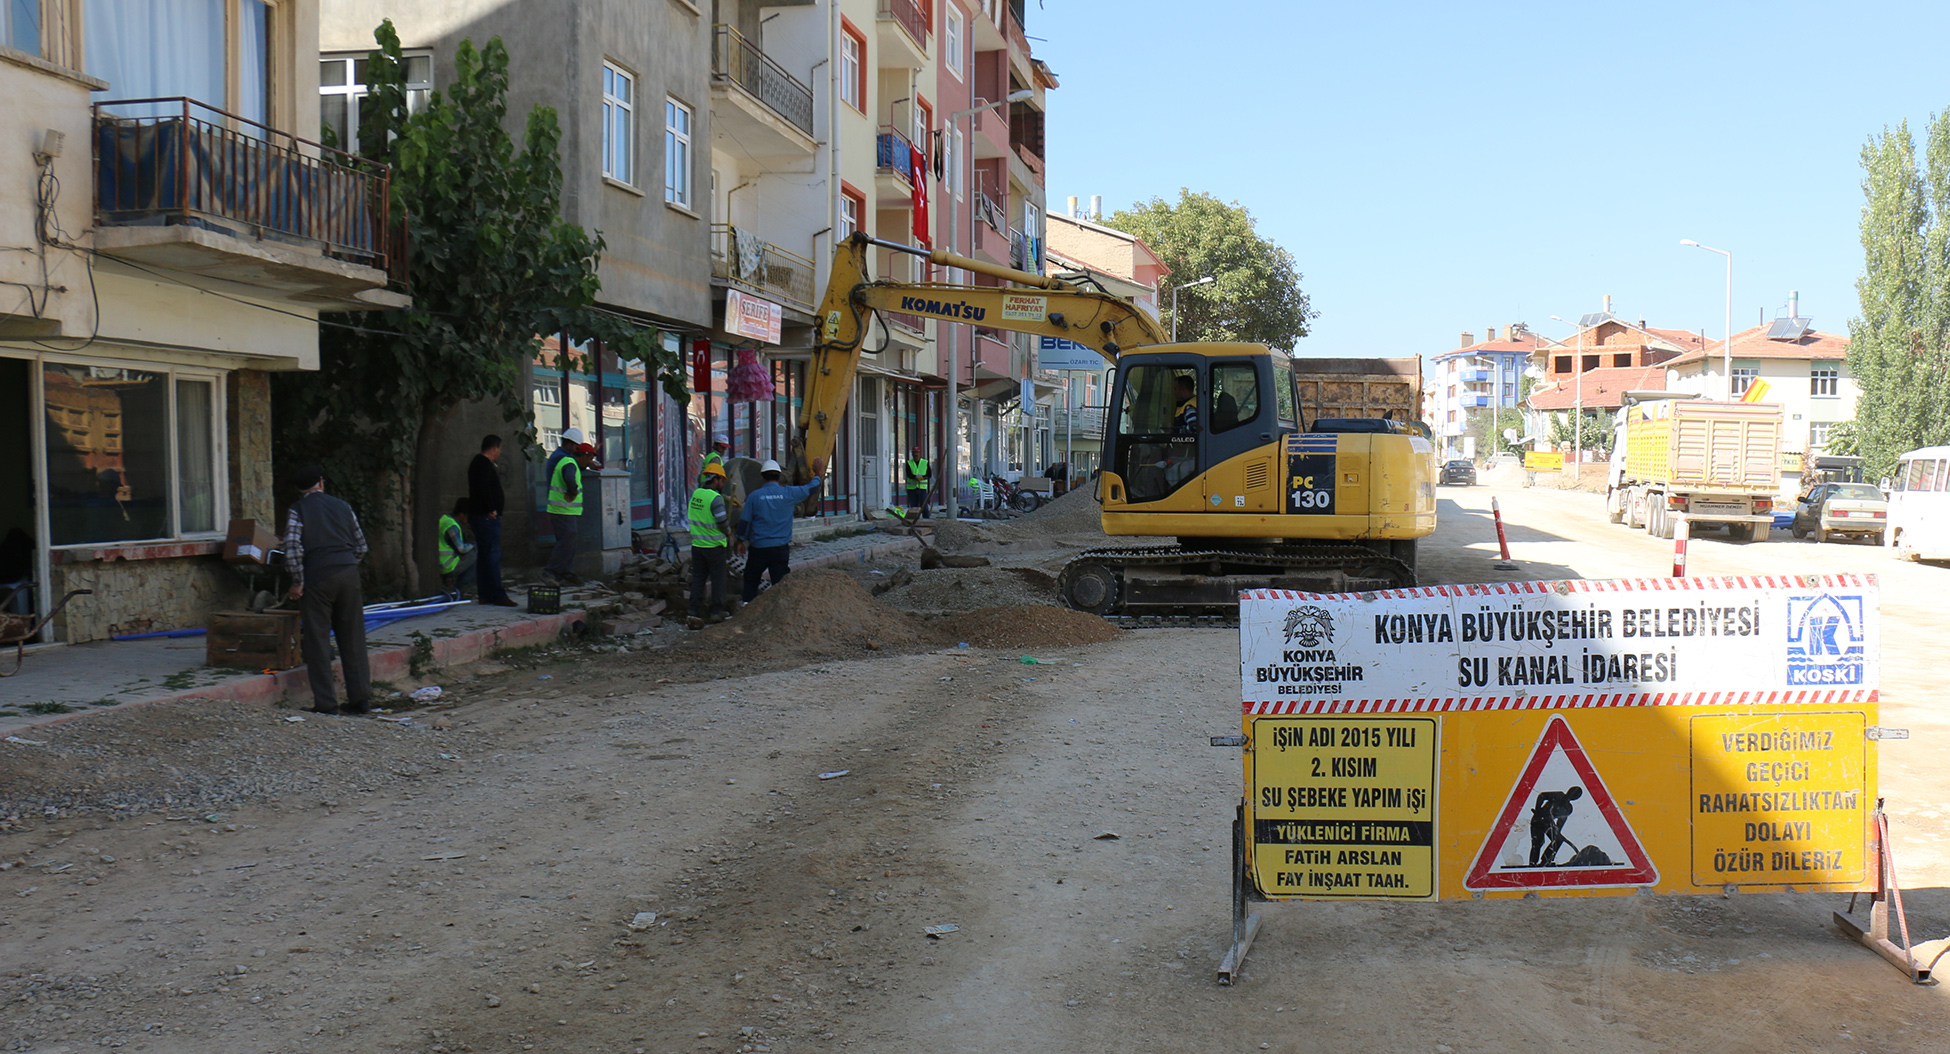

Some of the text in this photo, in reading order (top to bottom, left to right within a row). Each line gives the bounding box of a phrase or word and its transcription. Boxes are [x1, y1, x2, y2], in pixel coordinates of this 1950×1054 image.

[901, 296, 986, 321] KOMATSU
[1041, 335, 1092, 350] BEK
[1292, 476, 1313, 489] PC
[1291, 491, 1330, 508] 130
[1375, 600, 1760, 648] KONYA BÜYÜKŞEHİR BELEDİYESİ
[1283, 650, 1336, 662] KONYA
[1257, 663, 1364, 683] BÜYÜKŞEHİR
[1460, 646, 1676, 687] SU KANAL İDARESİ
[1793, 666, 1856, 683] KOSKİ
[1278, 683, 1342, 695] BELEDİYESİ
[1309, 728, 1335, 747] ADI
[1341, 727, 1381, 747] 2015
[1387, 728, 1416, 747] YILI
[1311, 757, 1377, 778] 2. KISIM
[1262, 787, 1282, 807] SU
[1288, 787, 1347, 813] ŞEBEKE
[1352, 787, 1402, 808] YAPIM
[1700, 791, 1858, 813] RAHATSIZLIKTAN
[1277, 822, 1411, 841] YÜKLENİCİ FİRMA
[1745, 821, 1811, 841] DOLAYI
[1337, 851, 1402, 866] ARSLAN
[1714, 848, 1764, 872] ÖZÜR
[1277, 869, 1410, 891] FAY İNŞAAT TAAH.
